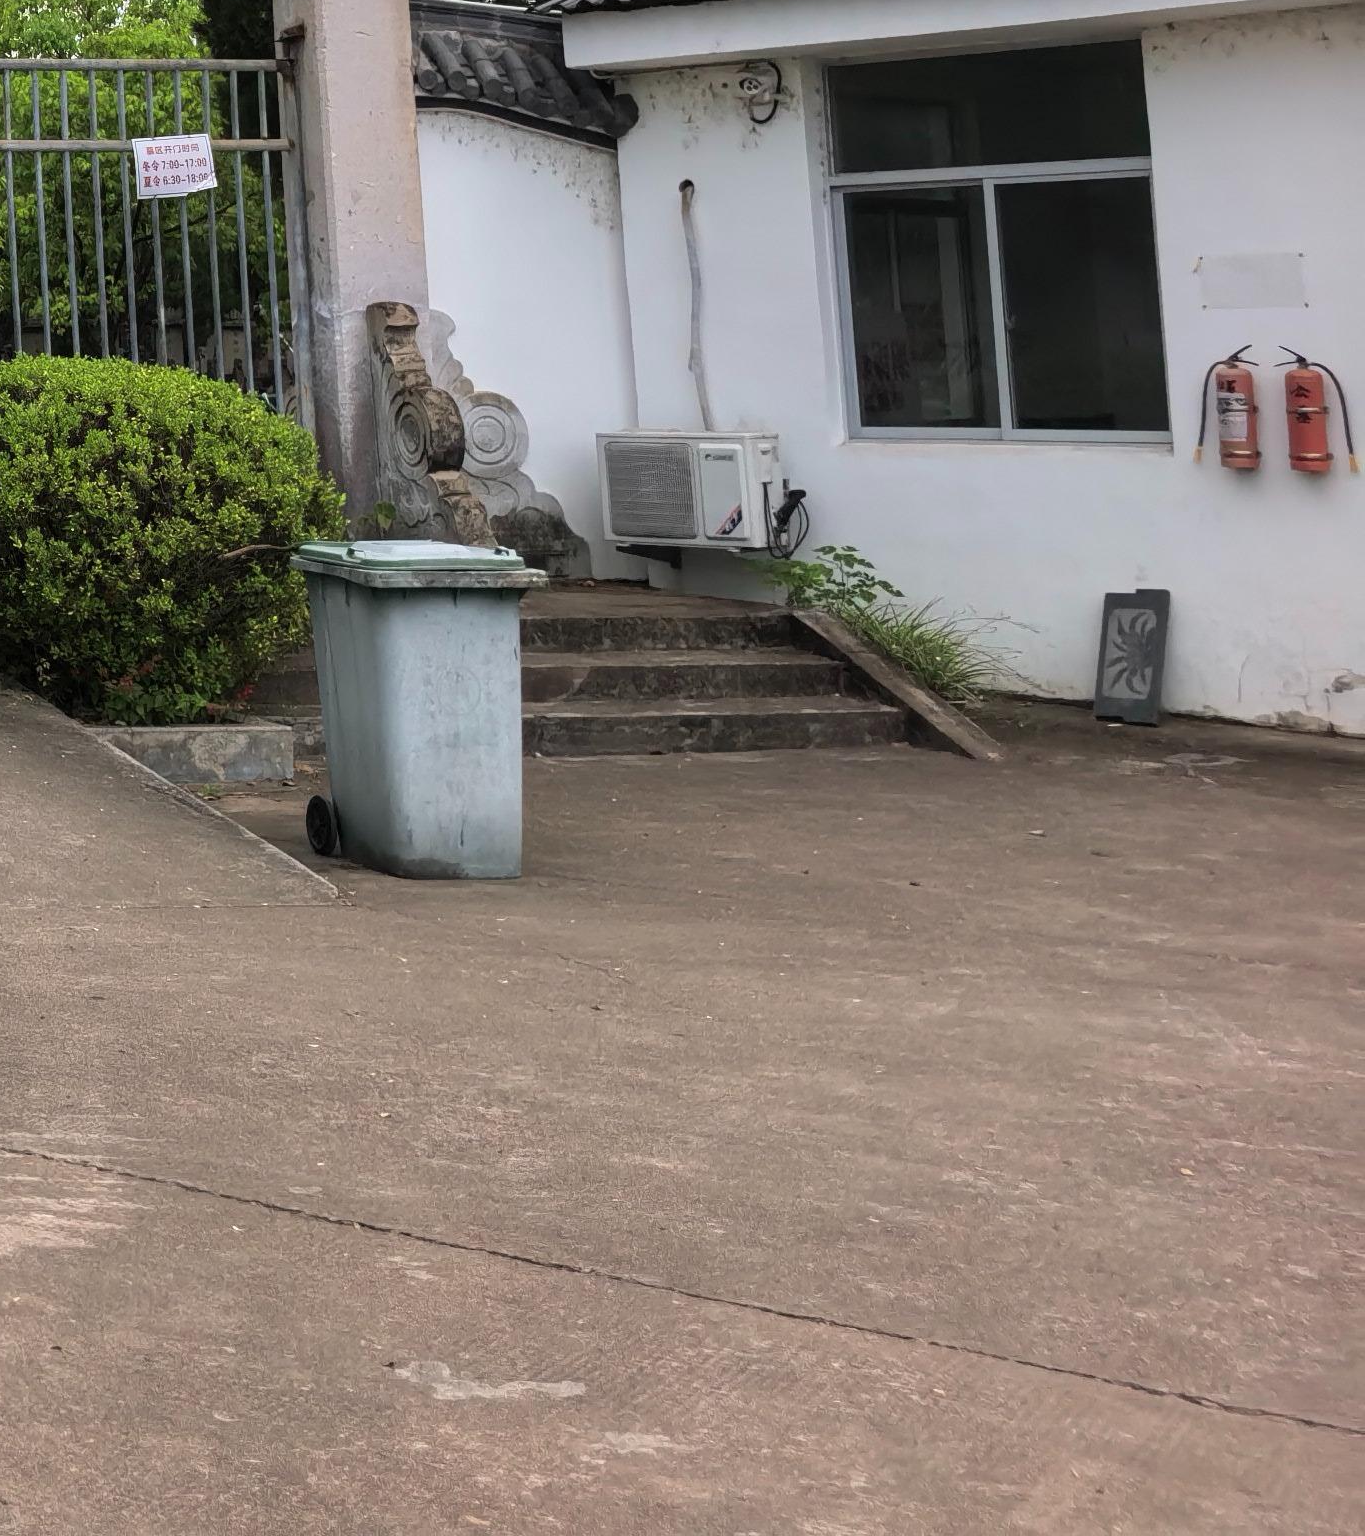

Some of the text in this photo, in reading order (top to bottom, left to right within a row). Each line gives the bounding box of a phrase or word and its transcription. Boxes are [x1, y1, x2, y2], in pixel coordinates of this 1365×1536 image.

[146, 143, 200, 156] 墓区开门时间
